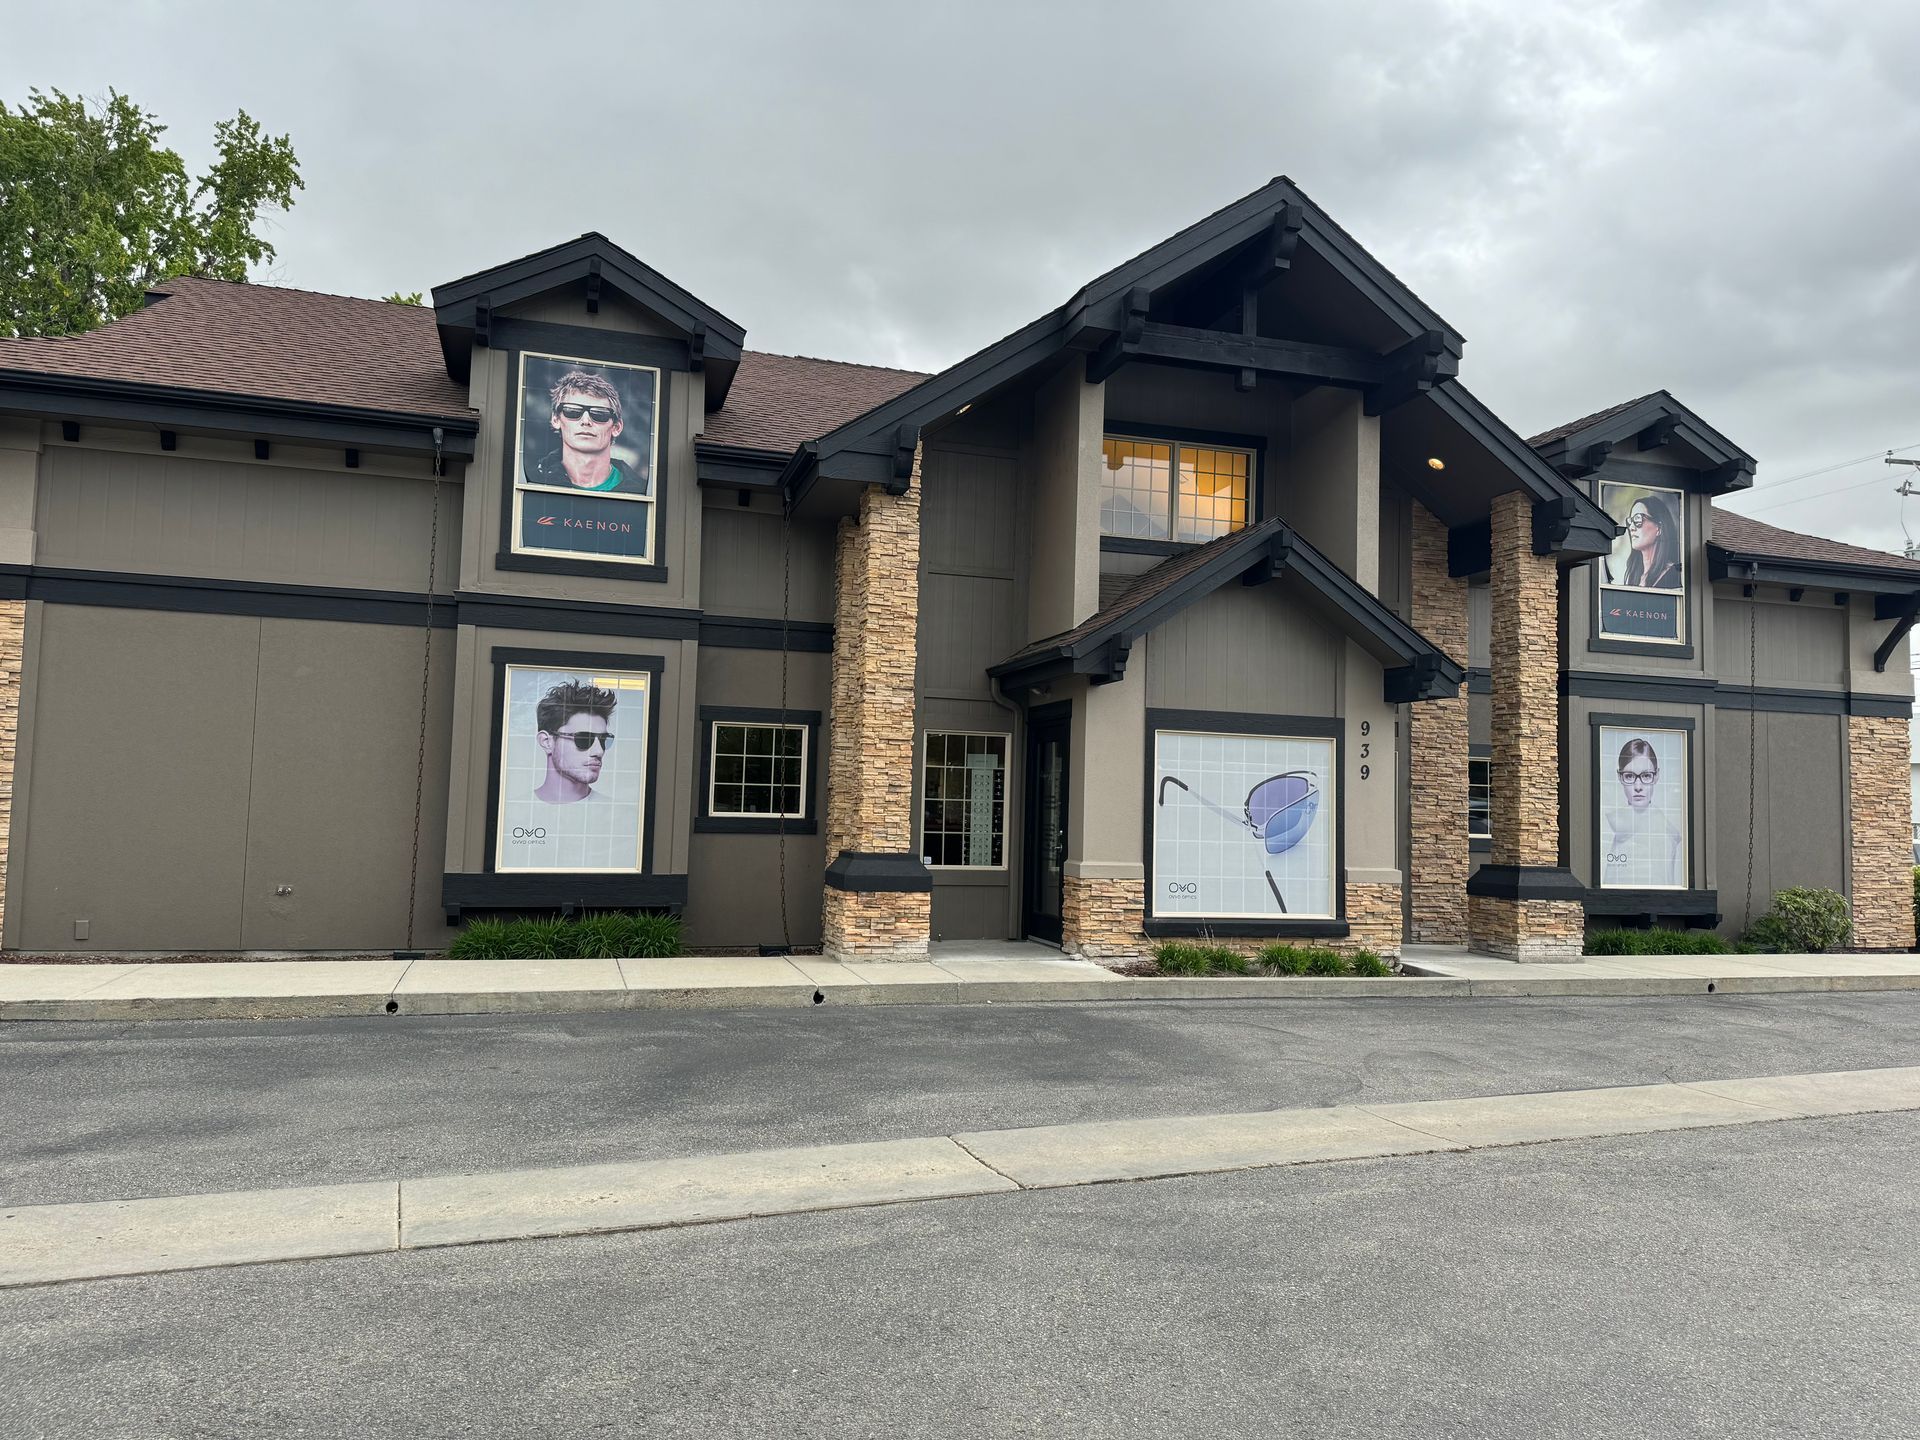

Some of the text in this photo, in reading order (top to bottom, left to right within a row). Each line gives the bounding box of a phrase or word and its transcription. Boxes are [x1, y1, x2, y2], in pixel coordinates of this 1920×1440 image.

[563, 517, 630, 533] KAENON
[1625, 609, 1667, 620] KAENON
[1360, 720, 1370, 781] 939
